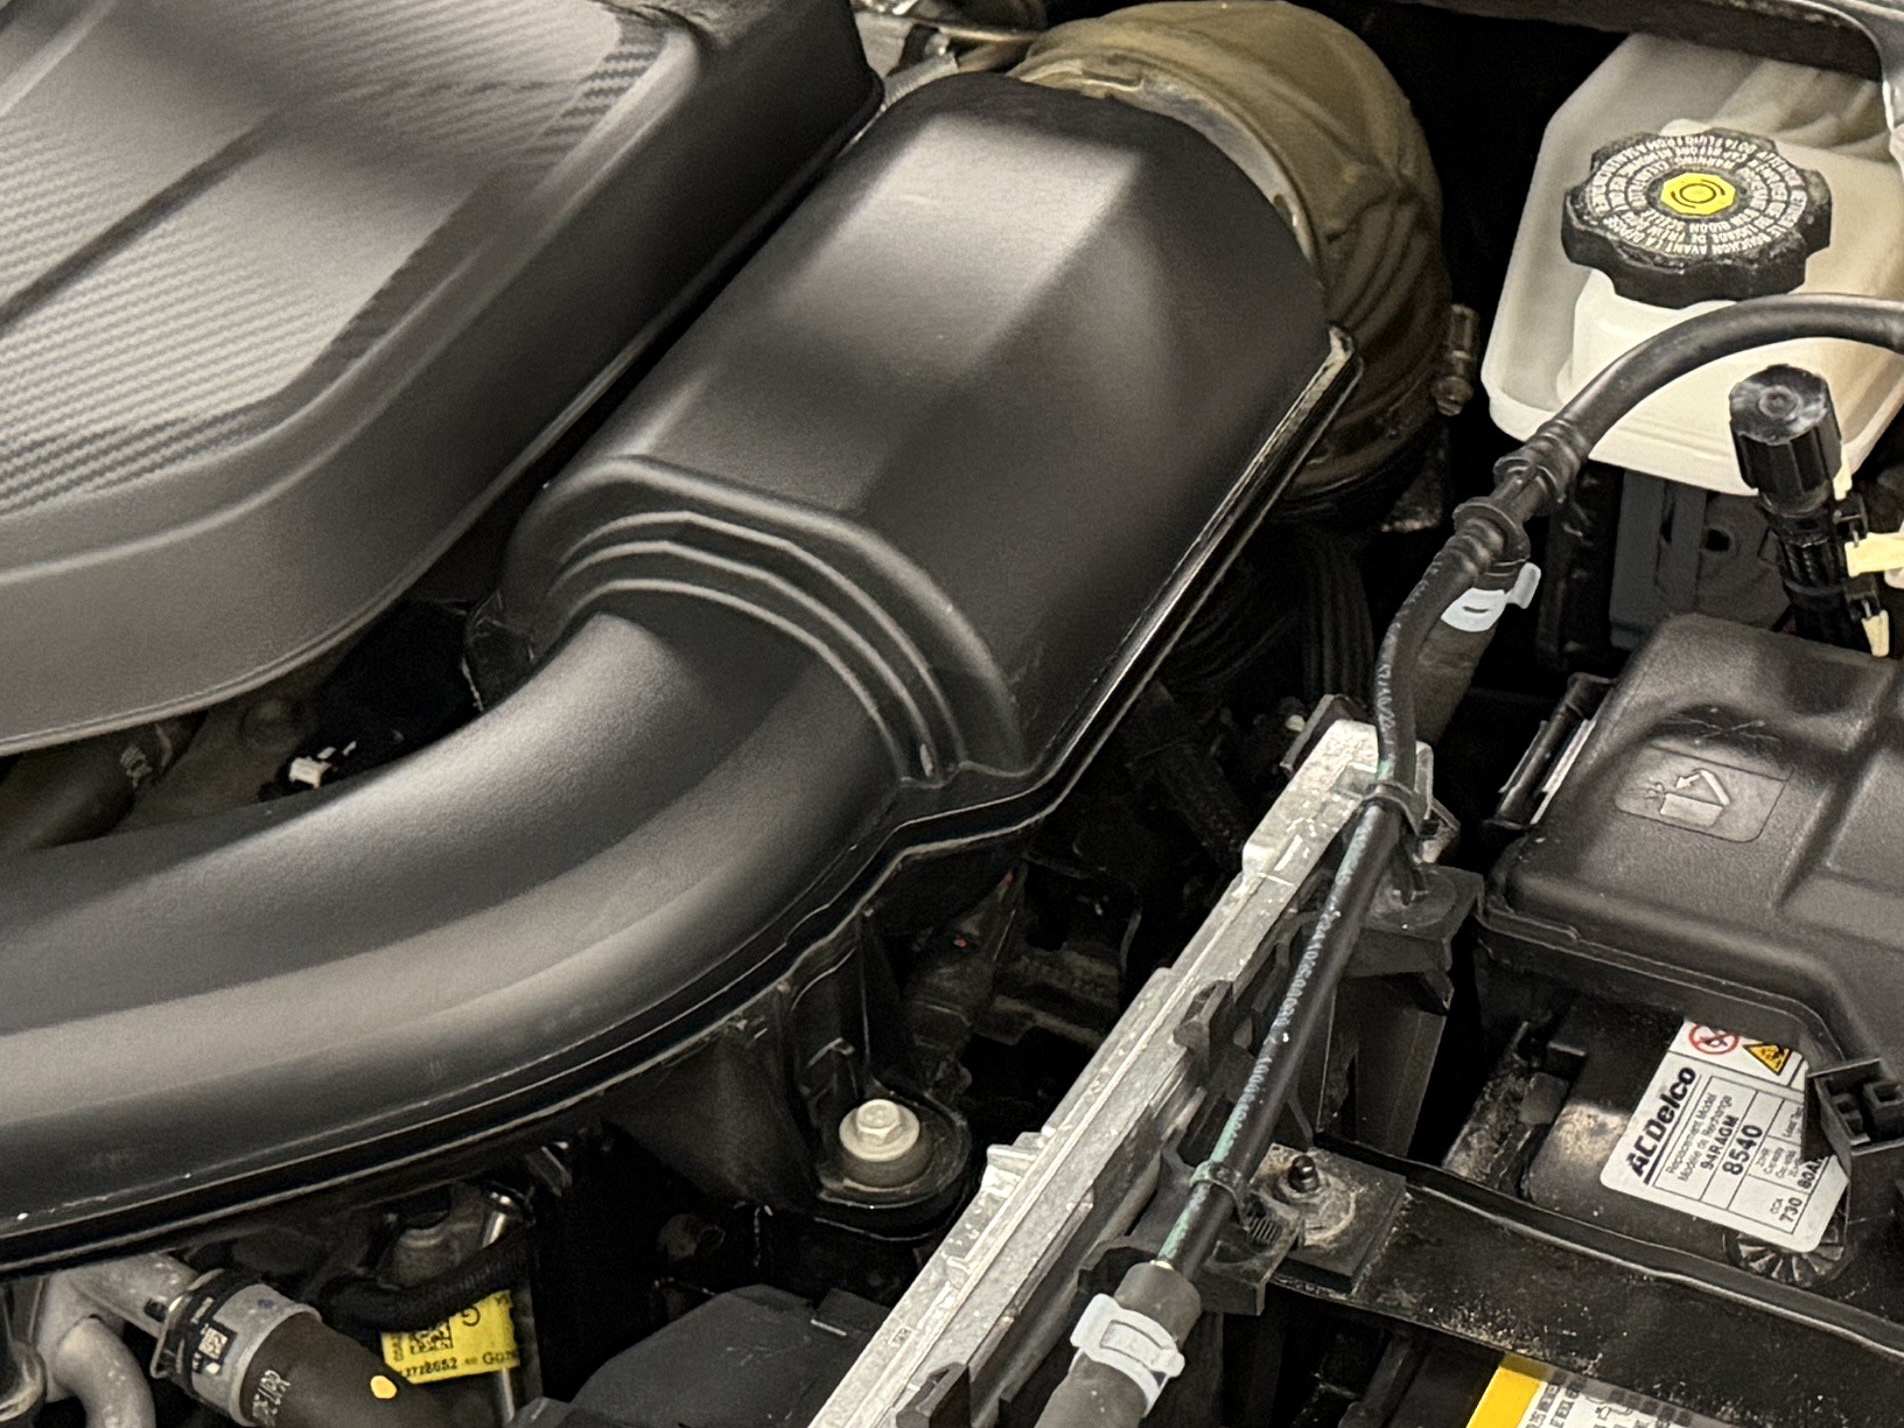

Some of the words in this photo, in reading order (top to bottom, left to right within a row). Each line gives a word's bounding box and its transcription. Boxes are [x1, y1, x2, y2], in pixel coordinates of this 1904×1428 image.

[1665, 242, 1707, 255] AVANT
[1624, 1064, 1697, 1177] ACDelco
[1698, 1113, 1739, 1171] 94RAGM
[1720, 1121, 1764, 1177] 8540
[1778, 1195, 1803, 1224] 730
